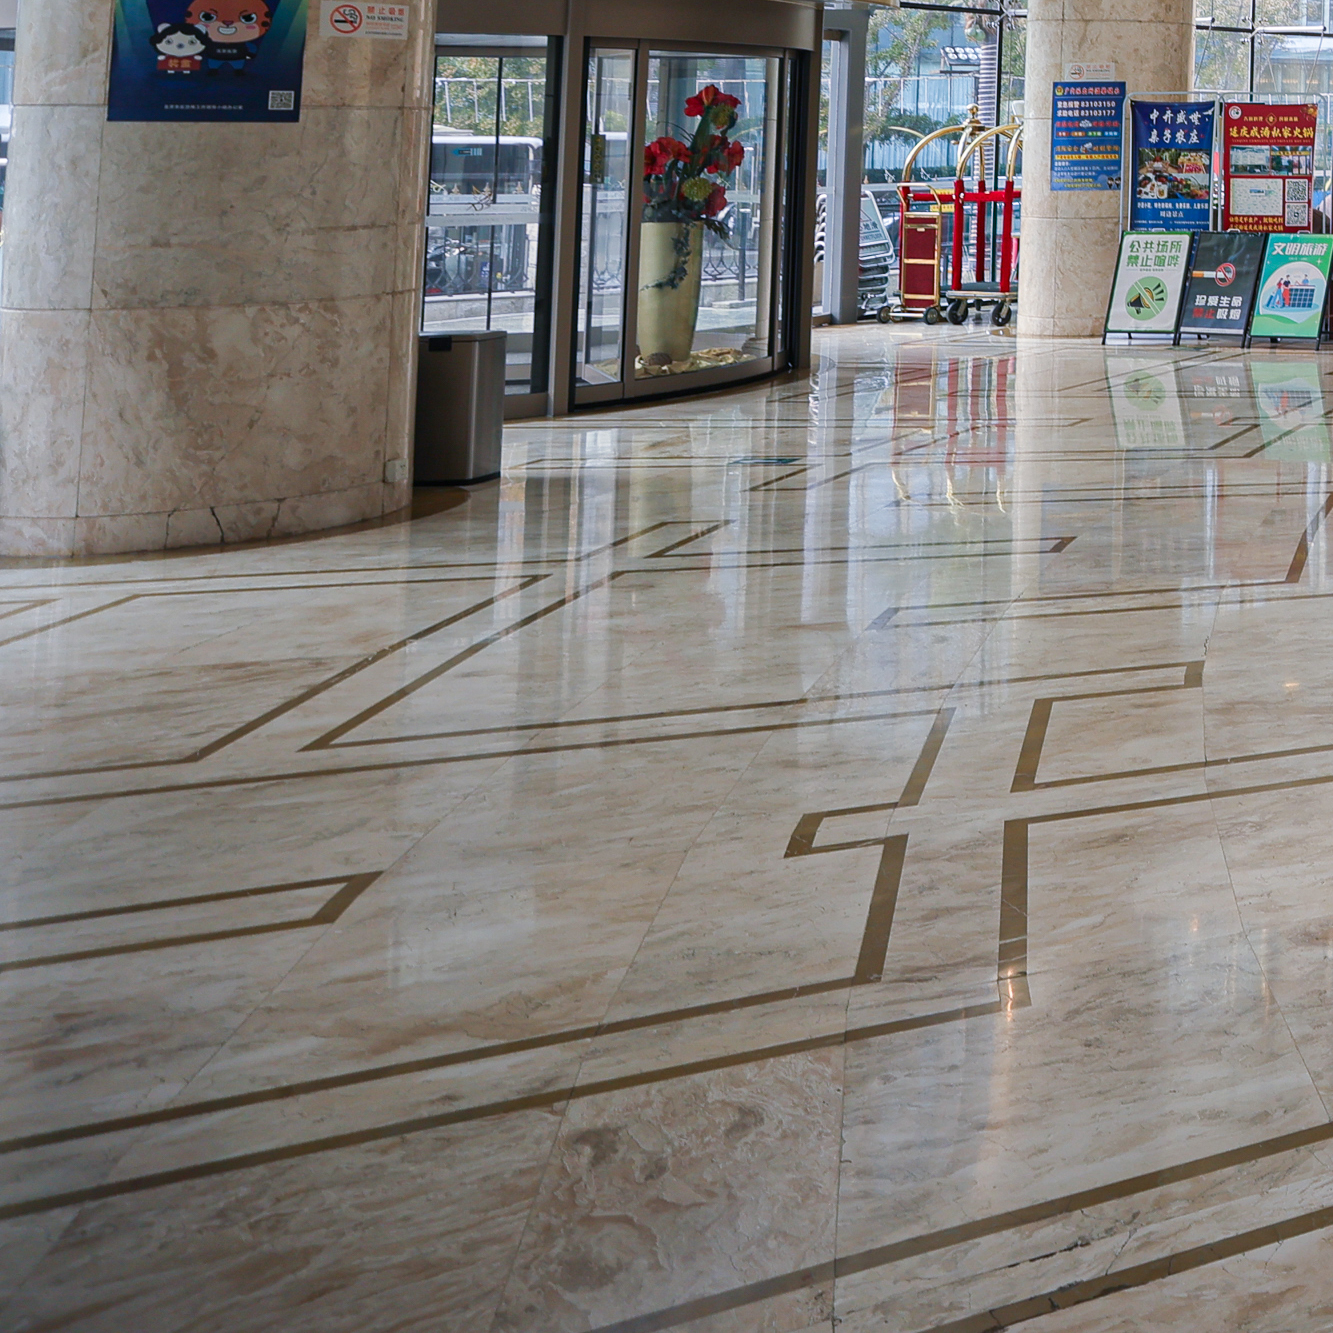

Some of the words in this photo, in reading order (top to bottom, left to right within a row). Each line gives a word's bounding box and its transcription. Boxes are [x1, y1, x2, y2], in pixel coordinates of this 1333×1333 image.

[1129, 240, 1183, 253] 公共场所
[1271, 242, 1329, 256] 文明旅游
[1126, 254, 1181, 267] 禁止喧哗
[1194, 294, 1243, 307] 珍爱生命
[1192, 307, 1242, 321] 禁止吸烟
